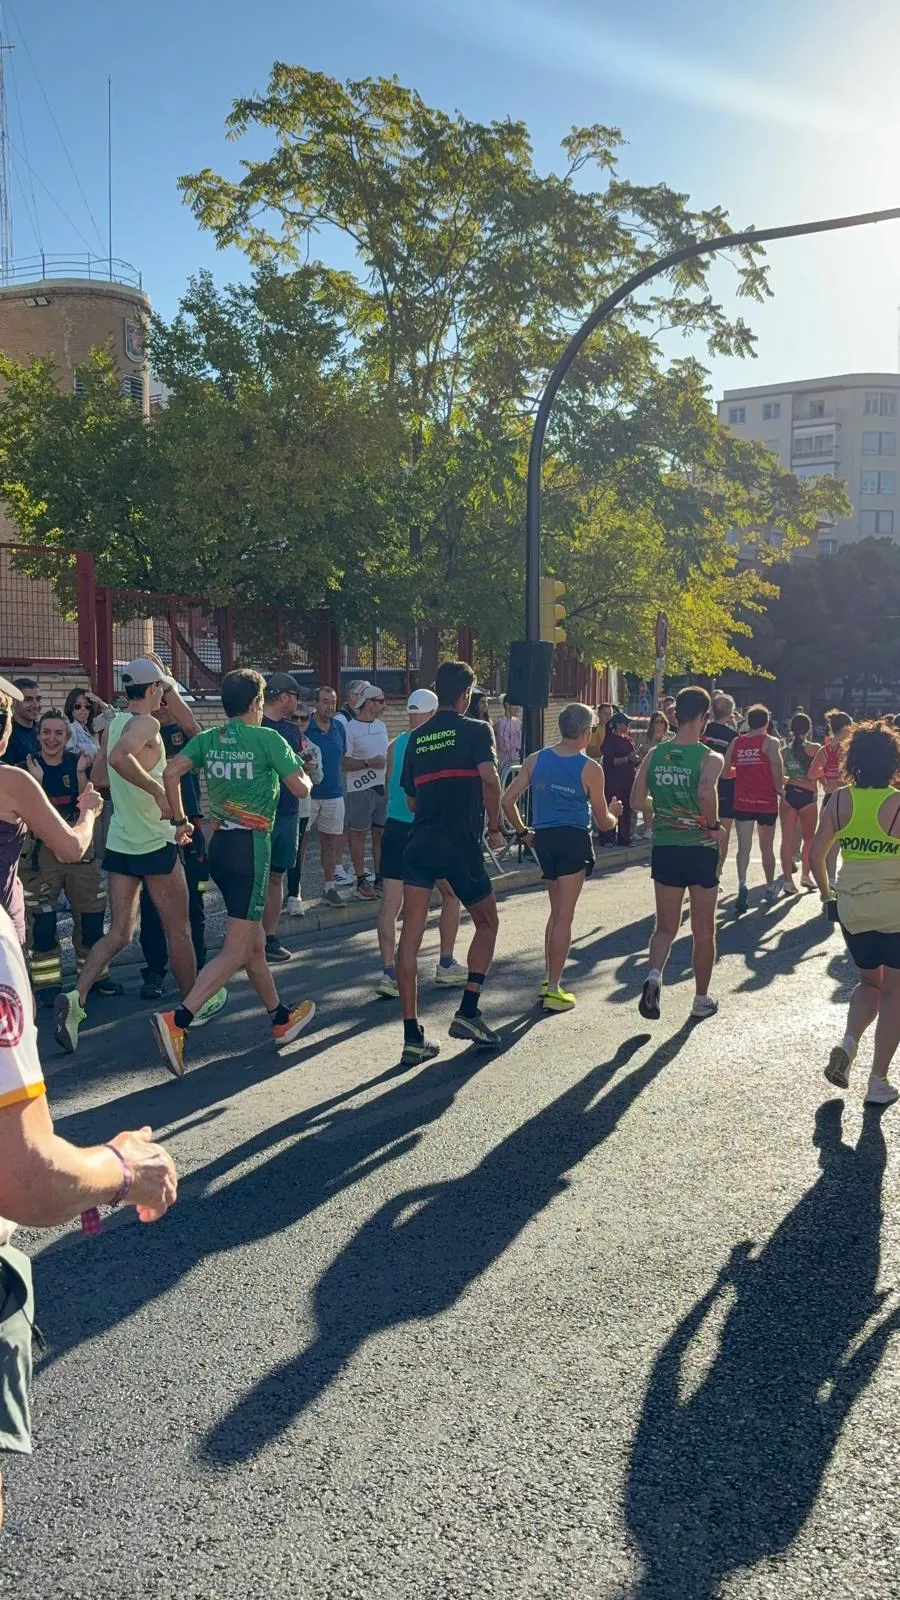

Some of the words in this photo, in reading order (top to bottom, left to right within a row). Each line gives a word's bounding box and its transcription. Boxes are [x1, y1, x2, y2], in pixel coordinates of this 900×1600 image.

[416, 729, 456, 745] BOMBEROS
[205, 749, 254, 760] ATLETISMO
[736, 748, 761, 758] ZGZ
[353, 770, 377, 789] 080
